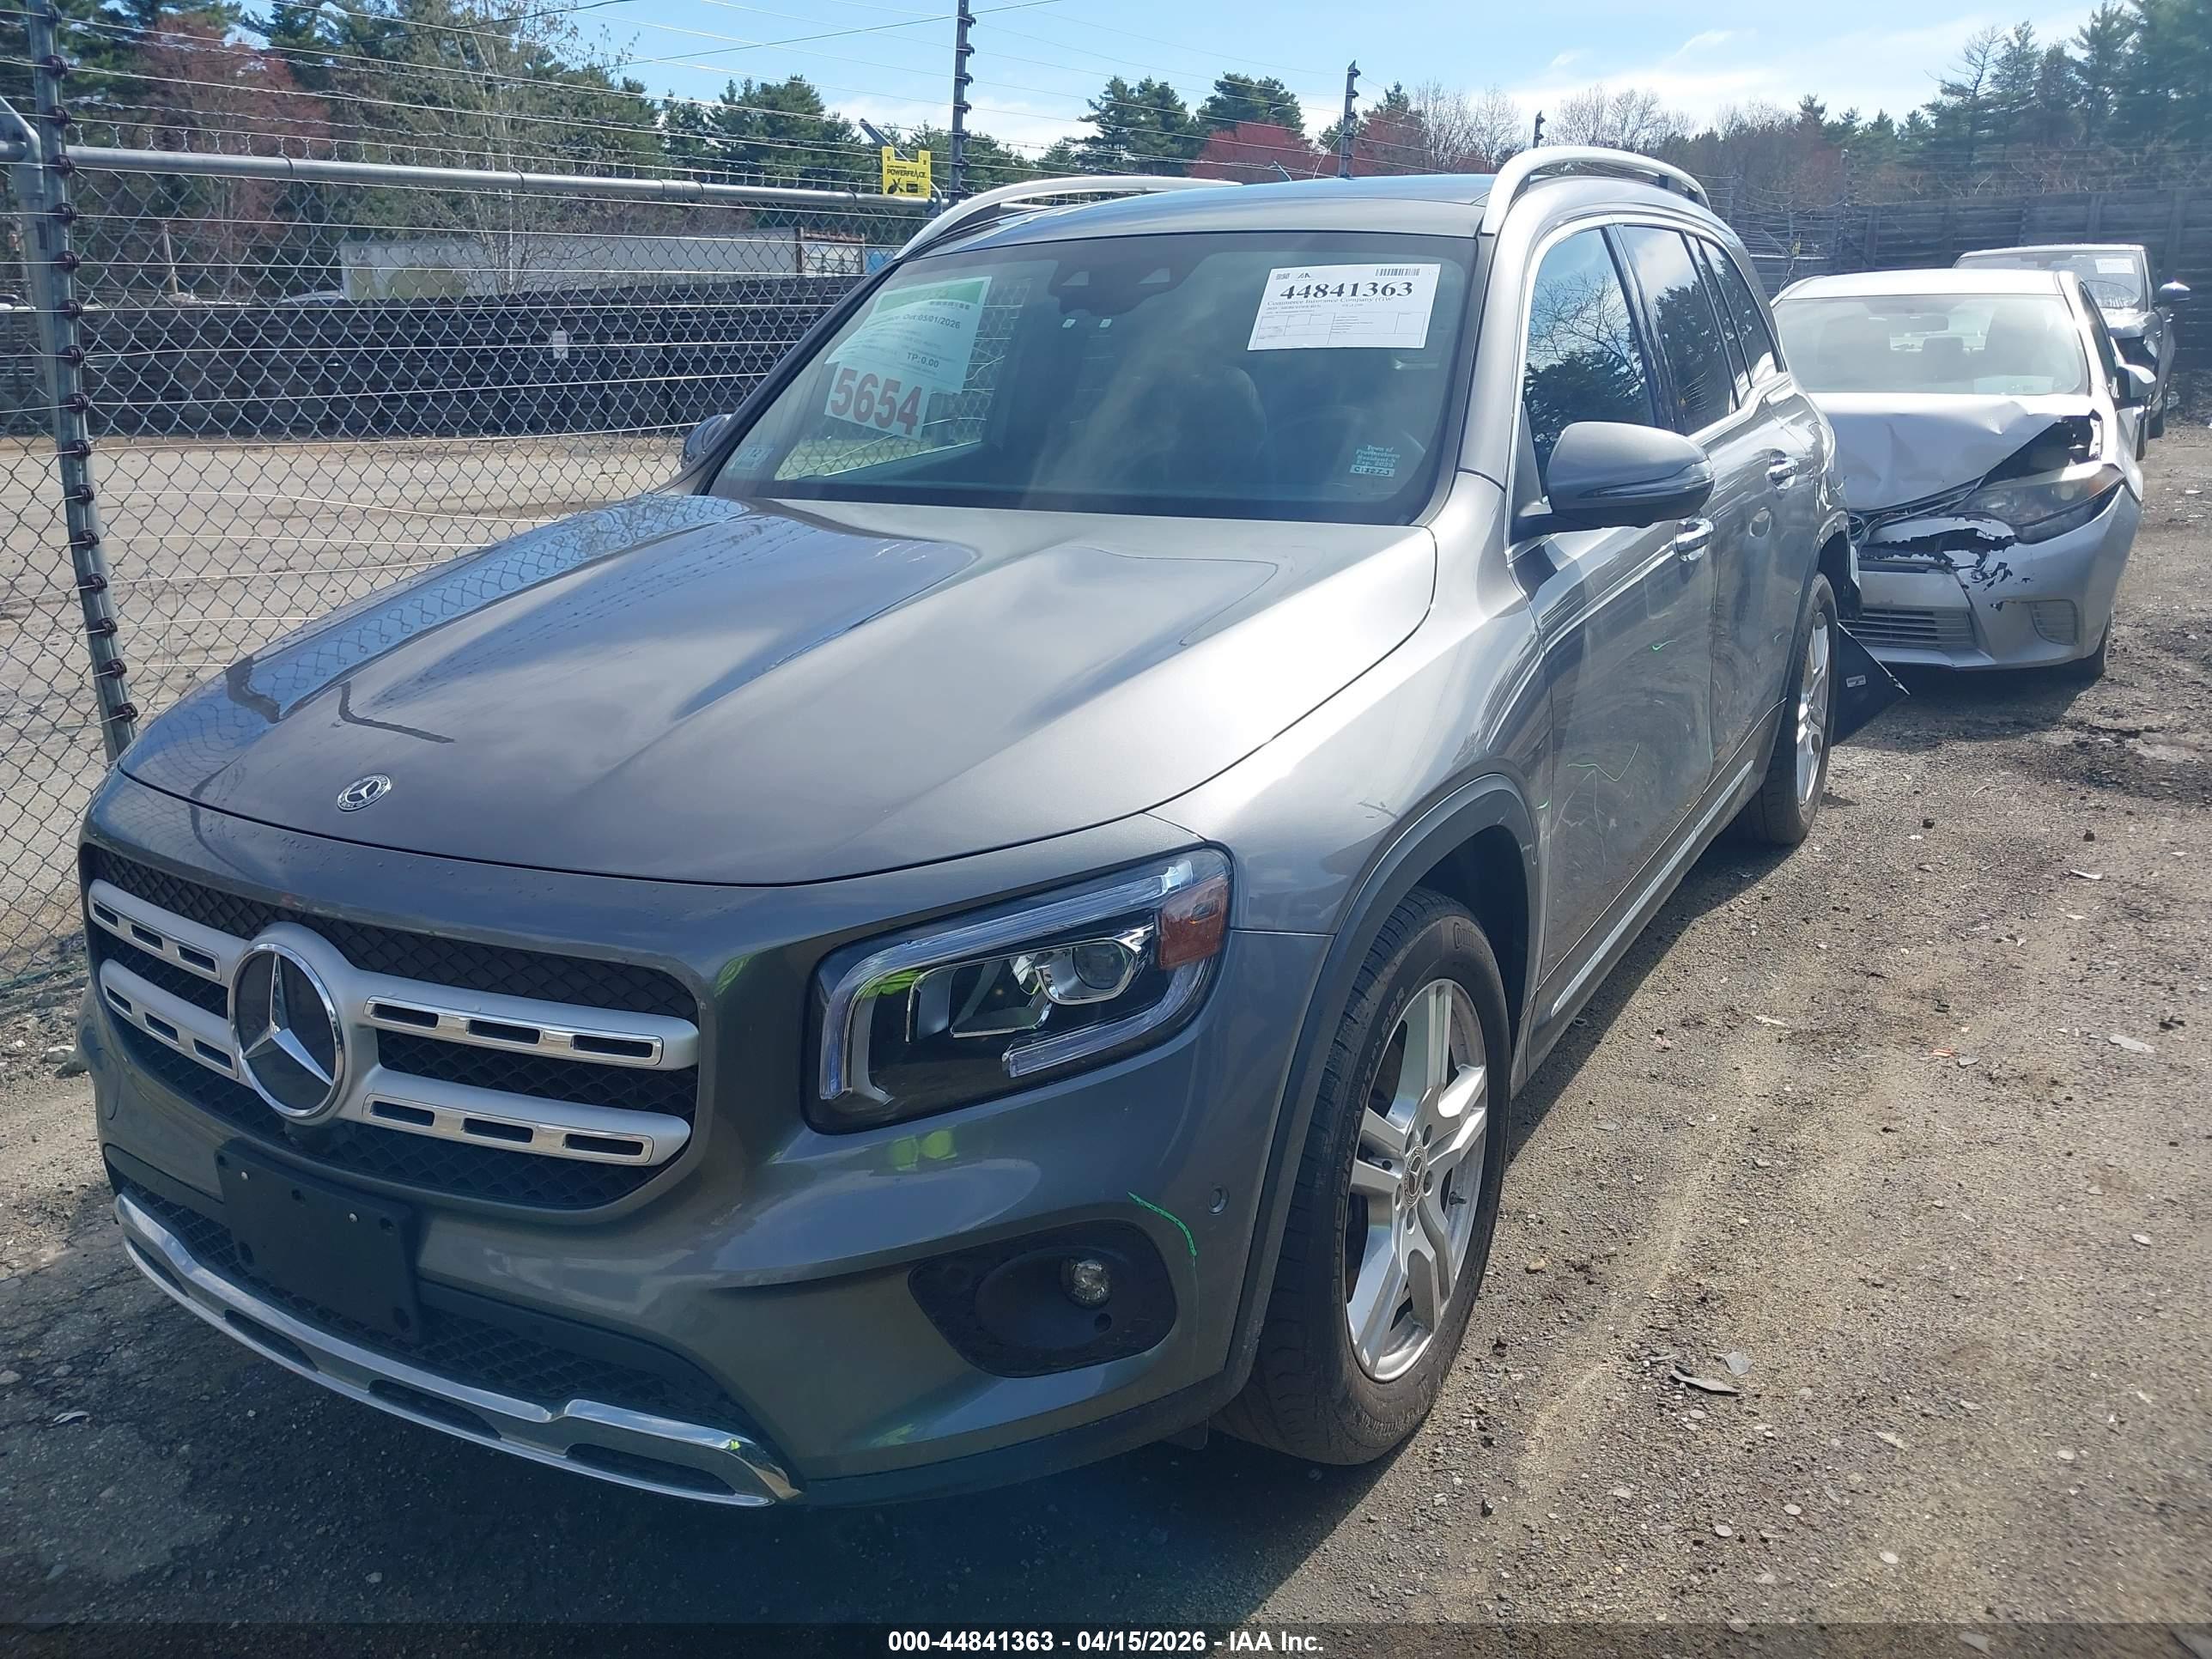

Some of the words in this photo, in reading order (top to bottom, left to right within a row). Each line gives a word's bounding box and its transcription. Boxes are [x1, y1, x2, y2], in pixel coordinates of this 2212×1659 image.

[1279, 282, 1413, 300] 44841363
[907, 352, 939, 368] TP:0.00
[830, 368, 922, 435] 5654
